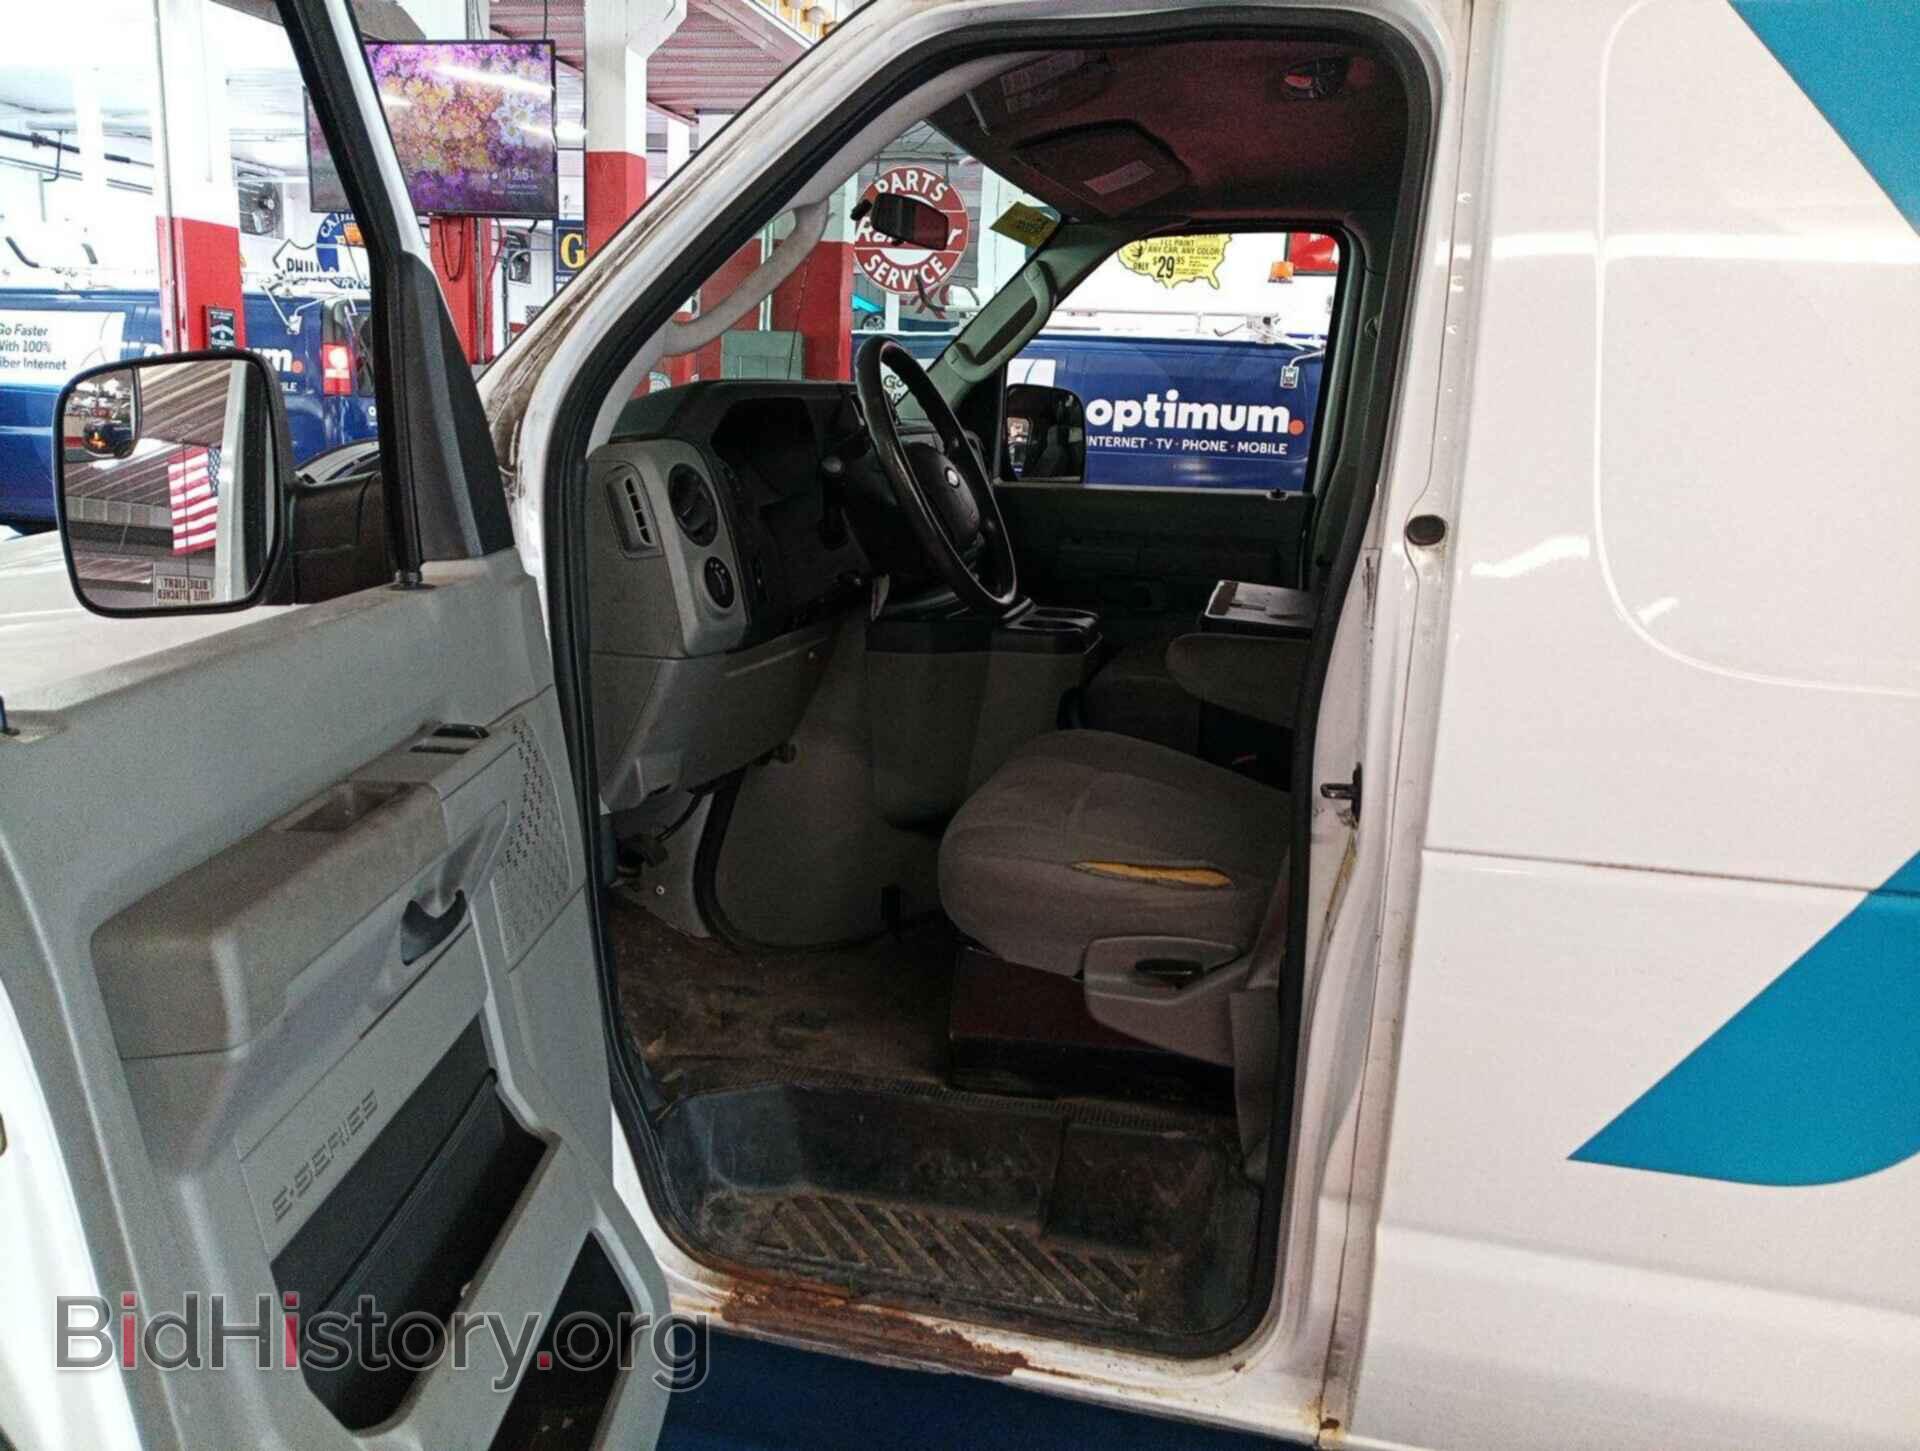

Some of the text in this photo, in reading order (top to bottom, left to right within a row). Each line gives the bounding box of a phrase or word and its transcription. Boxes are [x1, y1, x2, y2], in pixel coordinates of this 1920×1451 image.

[874, 169, 948, 202] PARTS
[1174, 239, 1194, 247] PAINT
[1181, 246, 1195, 255] ANY
[1196, 247, 1220, 255] COLOR
[1132, 261, 1149, 271] ONLY
[14, 323, 48, 337] Faster
[23, 340, 51, 353] 100%
[23, 357, 67, 370] Internet
[1086, 435, 1288, 455] INTERNET TV PHONE MOBILE
